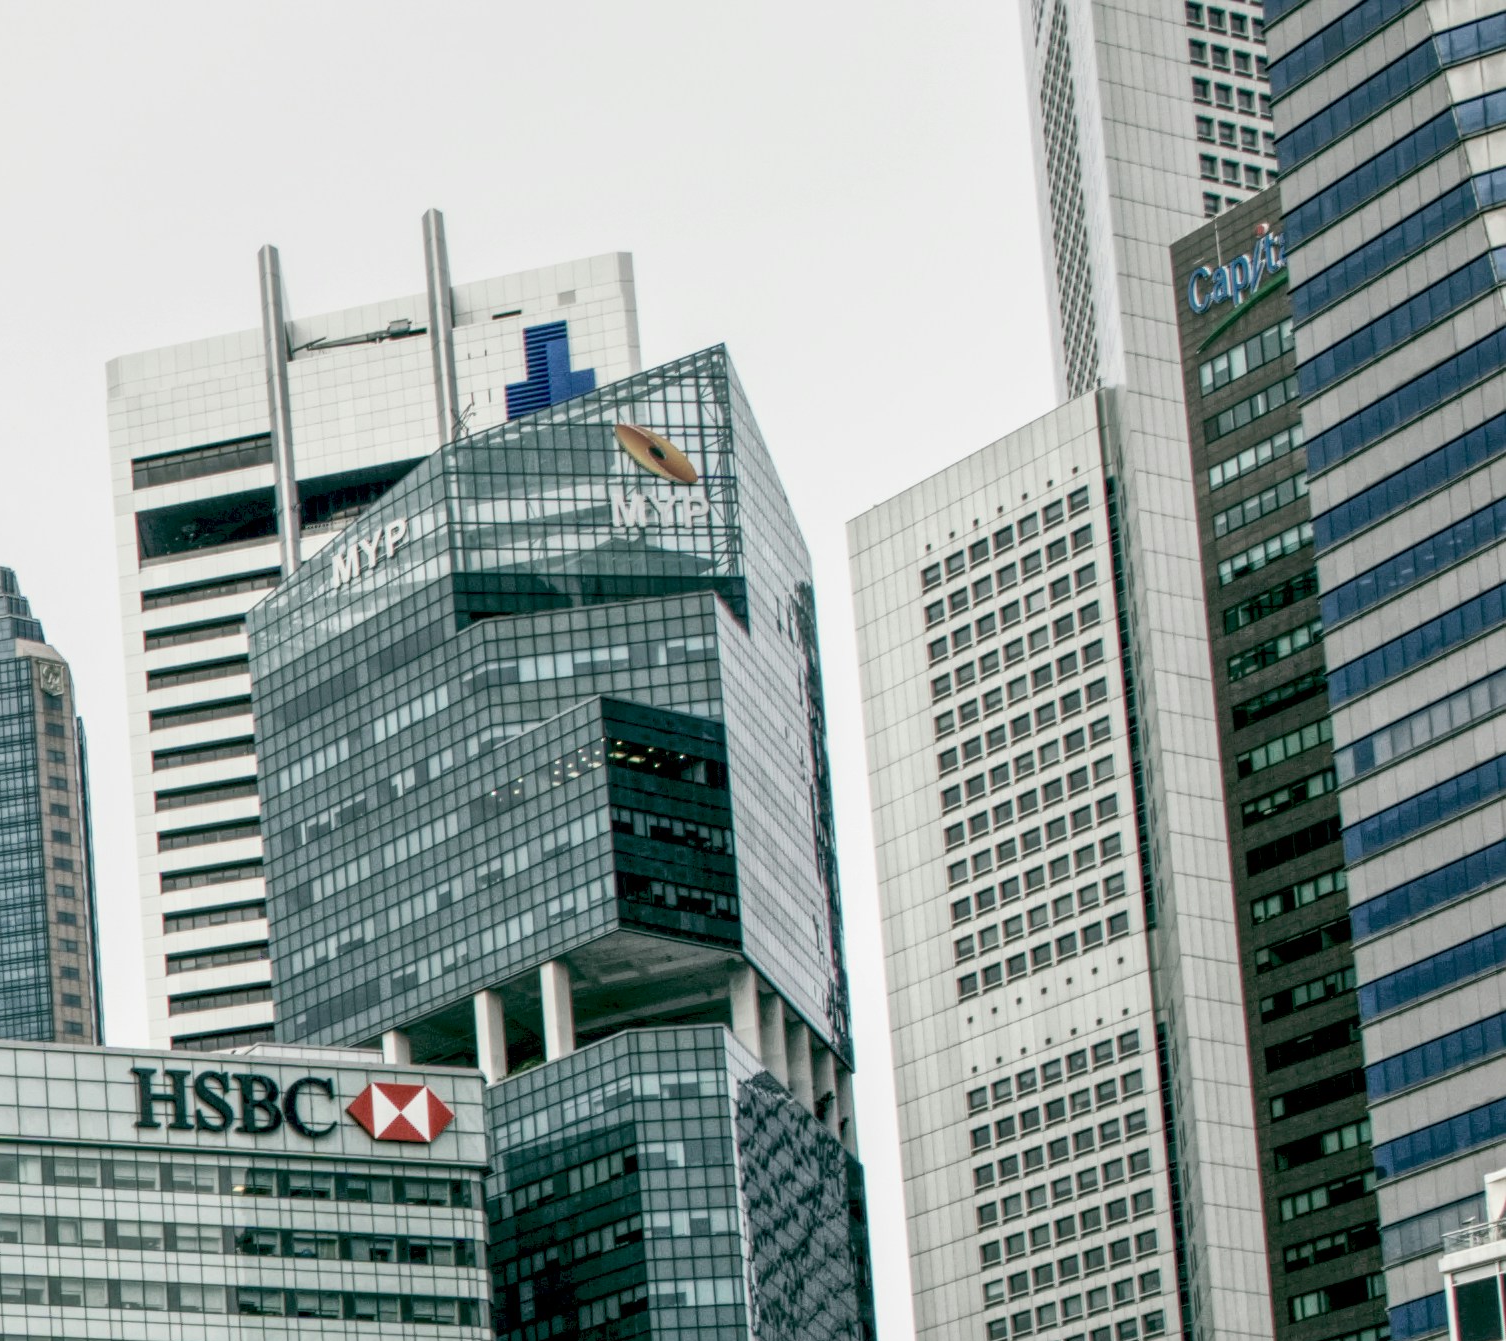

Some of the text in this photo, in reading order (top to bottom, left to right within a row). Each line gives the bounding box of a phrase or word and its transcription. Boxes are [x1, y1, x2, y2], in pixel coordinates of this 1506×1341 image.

[610, 492, 709, 529] MYP
[331, 518, 408, 588] MYP
[130, 1067, 338, 1139] HSBC
